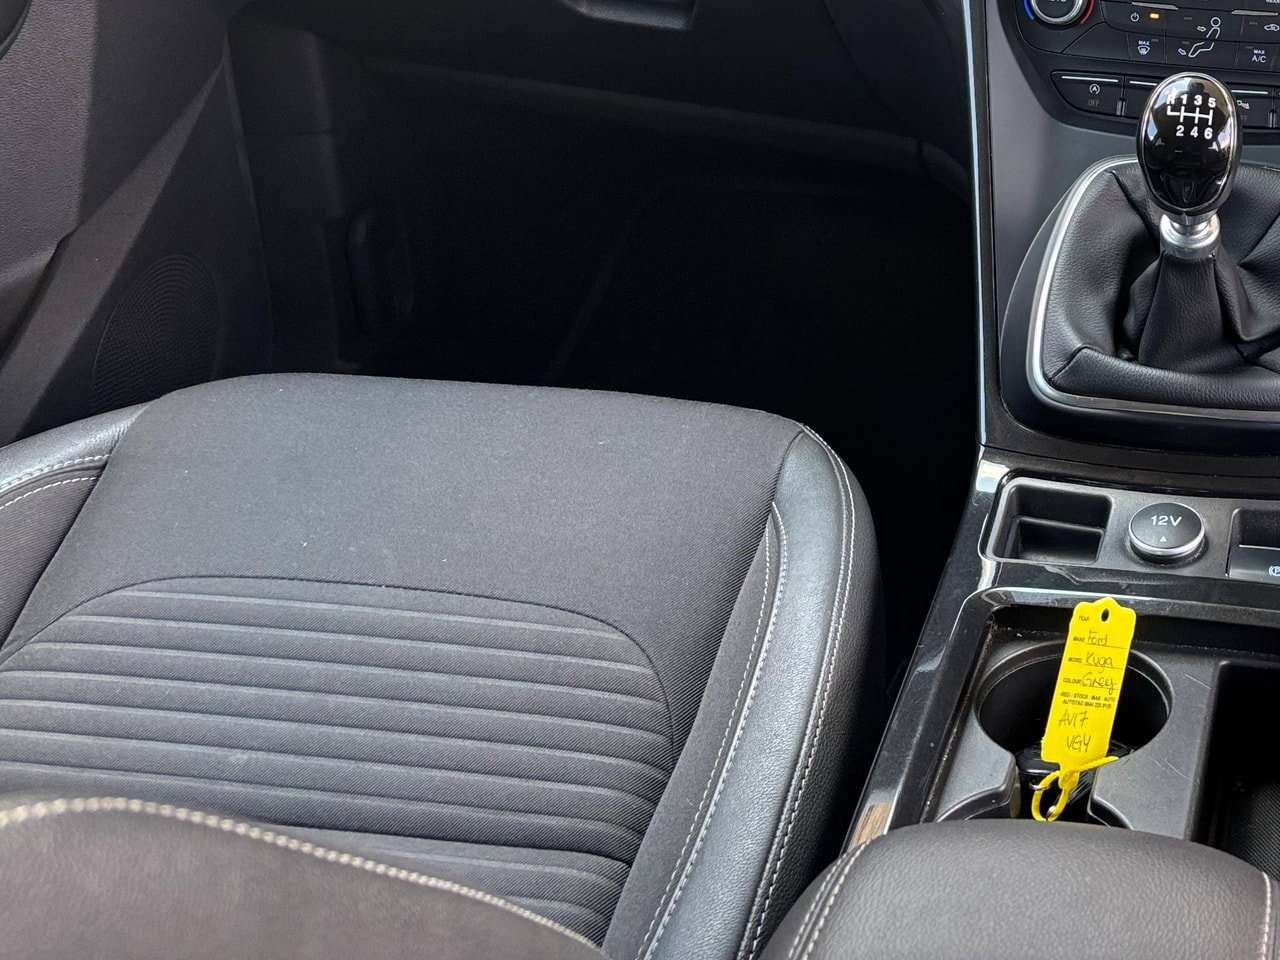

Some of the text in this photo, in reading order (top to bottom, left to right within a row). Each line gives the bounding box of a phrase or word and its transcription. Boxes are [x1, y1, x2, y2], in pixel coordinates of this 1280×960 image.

[1252, 54, 1267, 63] A/C
[1180, 94, 1188, 105] 1
[1193, 95, 1202, 105] 3
[1208, 97, 1216, 107] 5
[1176, 124, 1213, 139] 2 4 6
[1150, 514, 1182, 527] 12V
